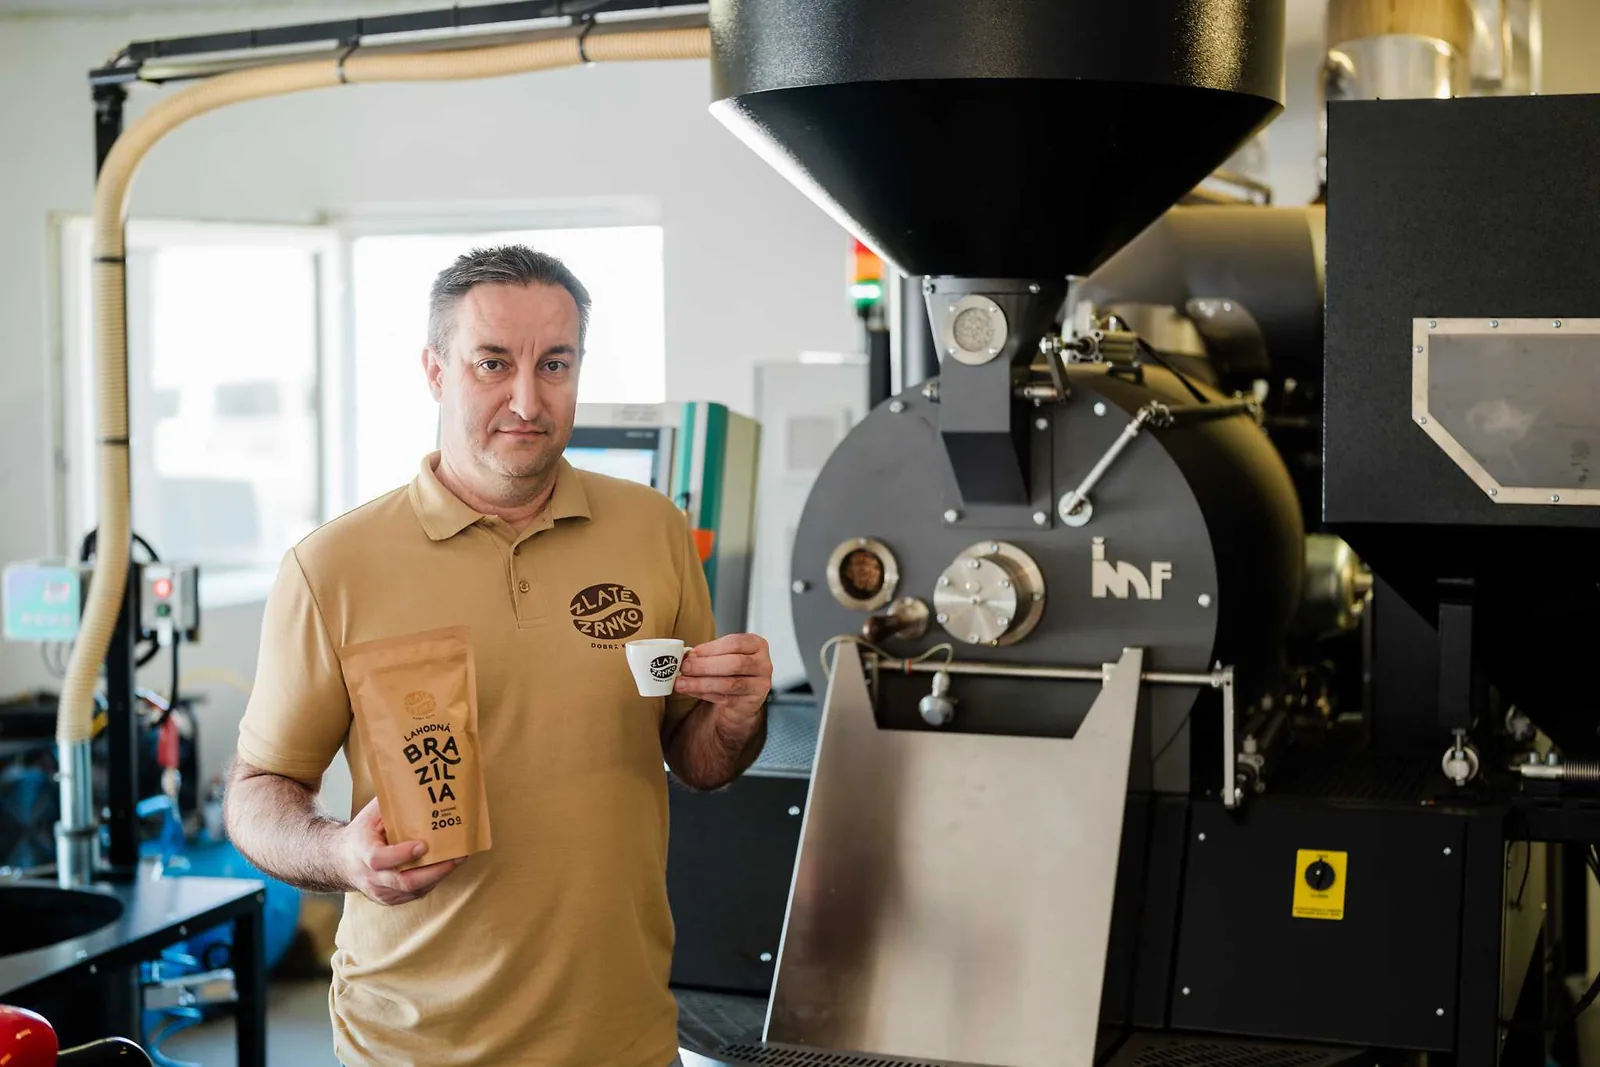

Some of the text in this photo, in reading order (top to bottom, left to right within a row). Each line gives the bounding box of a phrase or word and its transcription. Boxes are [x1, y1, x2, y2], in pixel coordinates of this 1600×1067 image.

[578, 609, 642, 637] ZRNKO
[404, 722, 451, 742] LAHODNÁ
[403, 736, 461, 765] BRA
[414, 757, 456, 786] ZÍL
[427, 783, 456, 804] IA
